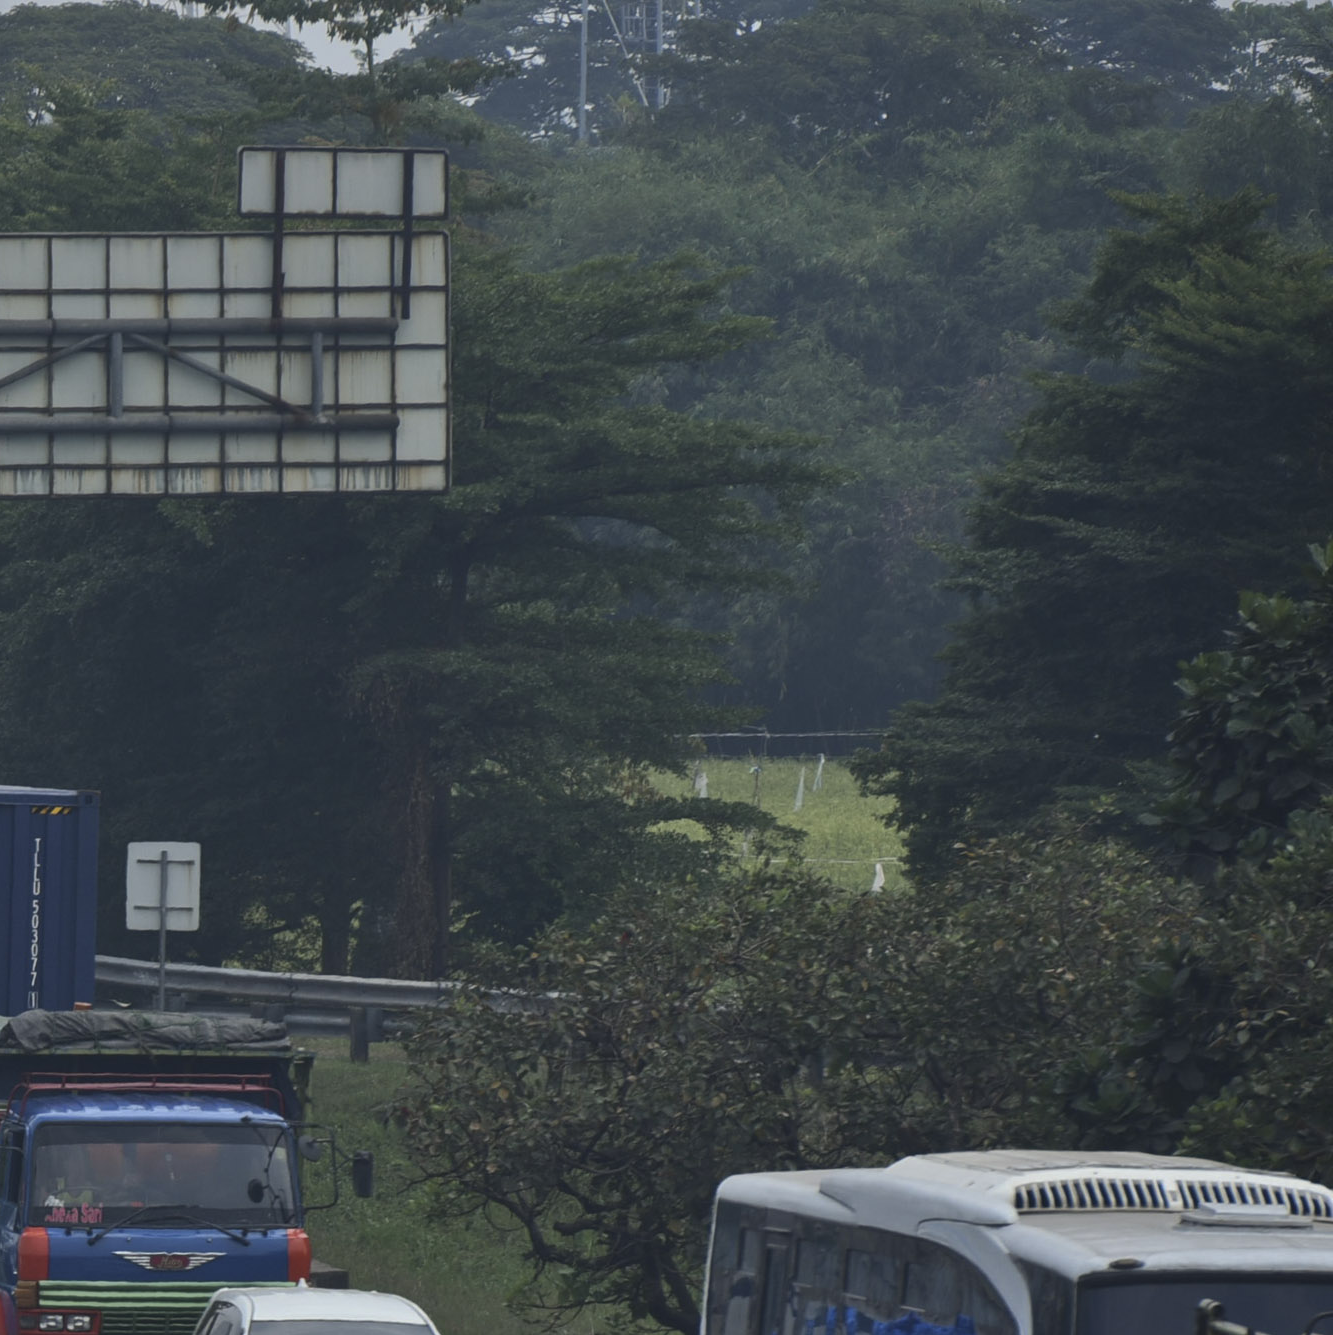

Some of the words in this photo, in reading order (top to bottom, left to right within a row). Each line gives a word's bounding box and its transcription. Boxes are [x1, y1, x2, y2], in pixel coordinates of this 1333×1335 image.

[32, 837, 42, 896] TLLU
[30, 899, 40, 987] 503077
[81, 1202, 104, 1224] Sari
